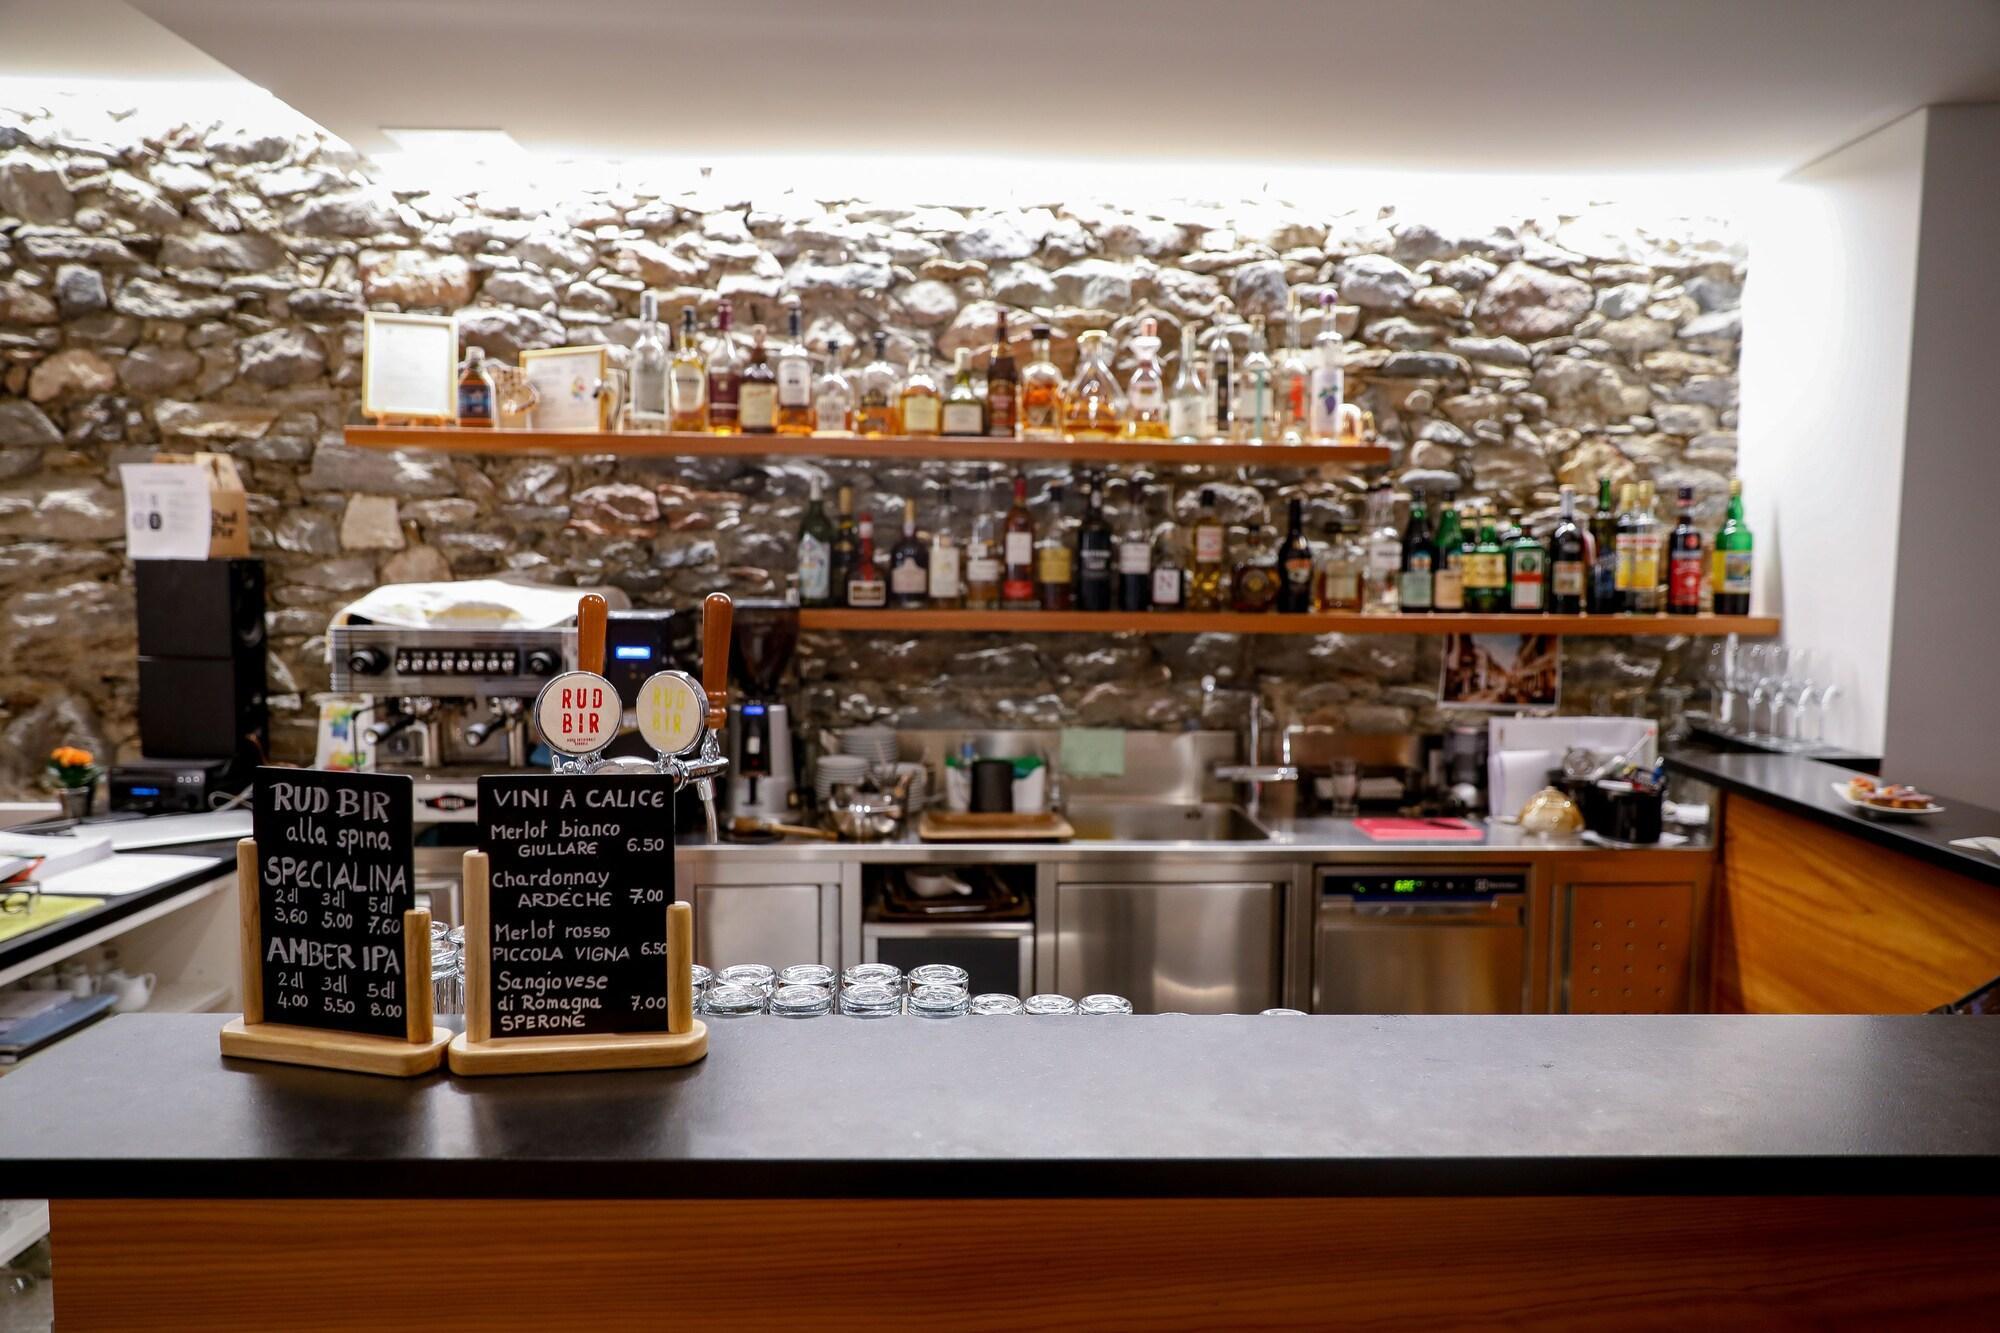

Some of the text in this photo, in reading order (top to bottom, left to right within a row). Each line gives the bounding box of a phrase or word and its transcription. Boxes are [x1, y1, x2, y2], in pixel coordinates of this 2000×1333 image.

[562, 688, 603, 709] RUD
[652, 686, 688, 710] RUD
[562, 713, 600, 734] BIR
[652, 713, 683, 734] BIR
[269, 782, 391, 823] RUD BIR
[493, 788, 549, 809] VINI
[586, 789, 665, 808] CALICE
[286, 816, 392, 856] alla spina
[490, 819, 621, 840] Merlot bianco
[518, 838, 665, 858] GIULLARE 6.50
[264, 855, 407, 895] SPECIALINA
[492, 868, 610, 889] Chardonnay
[628, 888, 664, 905] 7.00
[321, 911, 353, 929] 5.00
[494, 919, 611, 942] Merlot rosso
[266, 936, 401, 975] AMBER IPA
[492, 947, 564, 962] PICCOLA
[575, 946, 631, 962] VIGNA
[277, 991, 403, 1018] 4.00 5.50 8.00
[497, 994, 667, 1015] di Romagna 7.00
[500, 1014, 586, 1032] SPERONE
